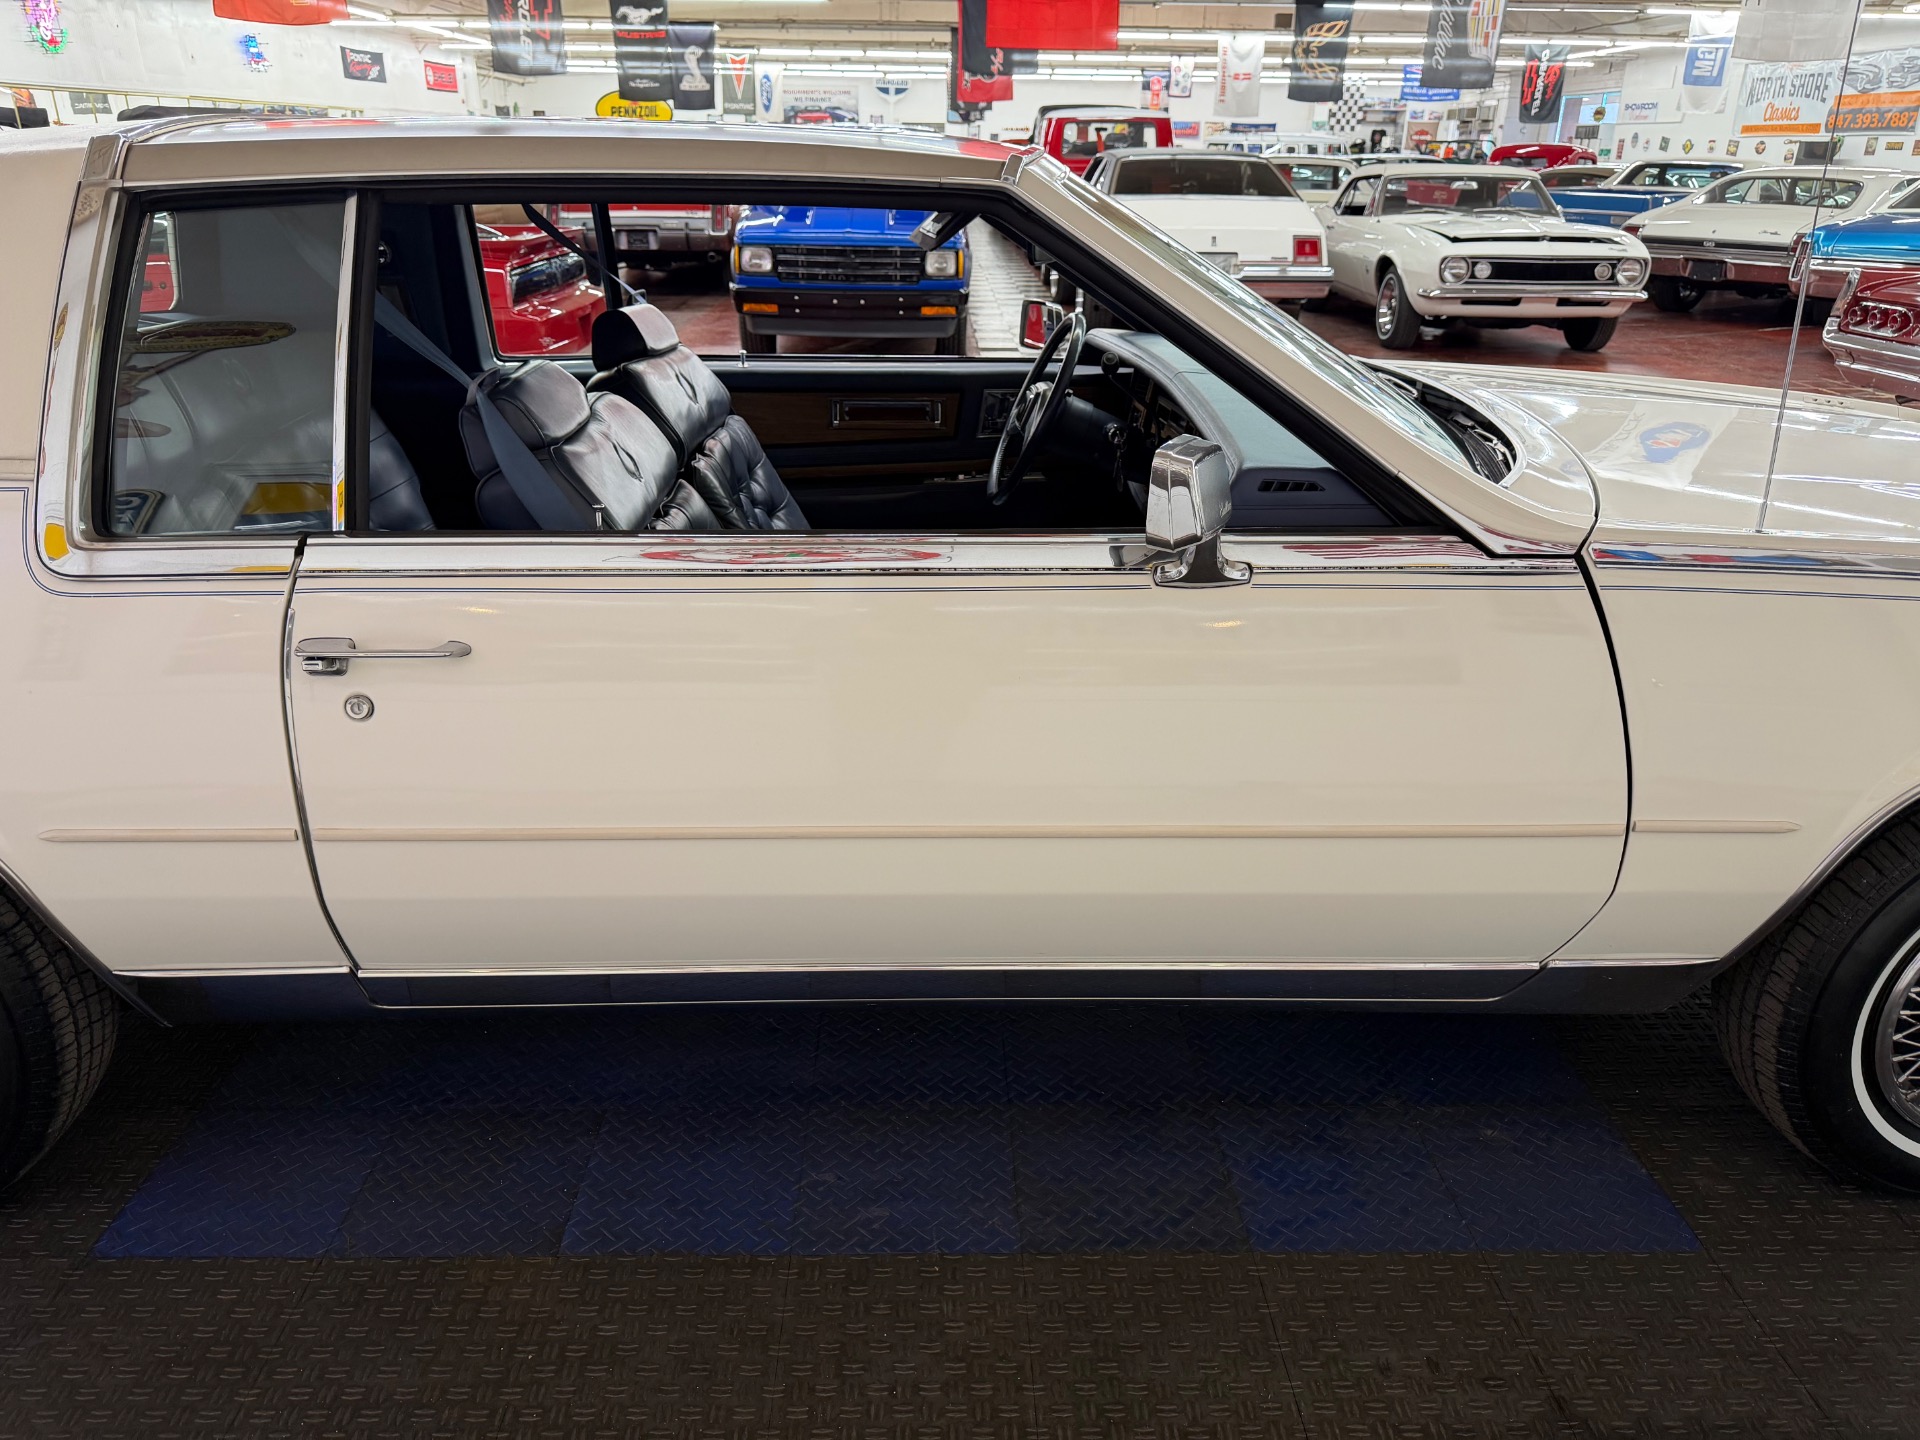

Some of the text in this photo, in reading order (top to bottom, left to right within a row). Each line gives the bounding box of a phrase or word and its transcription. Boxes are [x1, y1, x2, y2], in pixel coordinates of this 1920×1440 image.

[616, 30, 666, 39] MUSTANG
[761, 78, 771, 106] Ford
[1745, 76, 1788, 108] NORTH
[1788, 71, 1833, 104] SHORE
[610, 105, 660, 118] PENNZOIL
[1763, 101, 1801, 122] Classics
[1827, 111, 1919, 129] 847.393.7887
